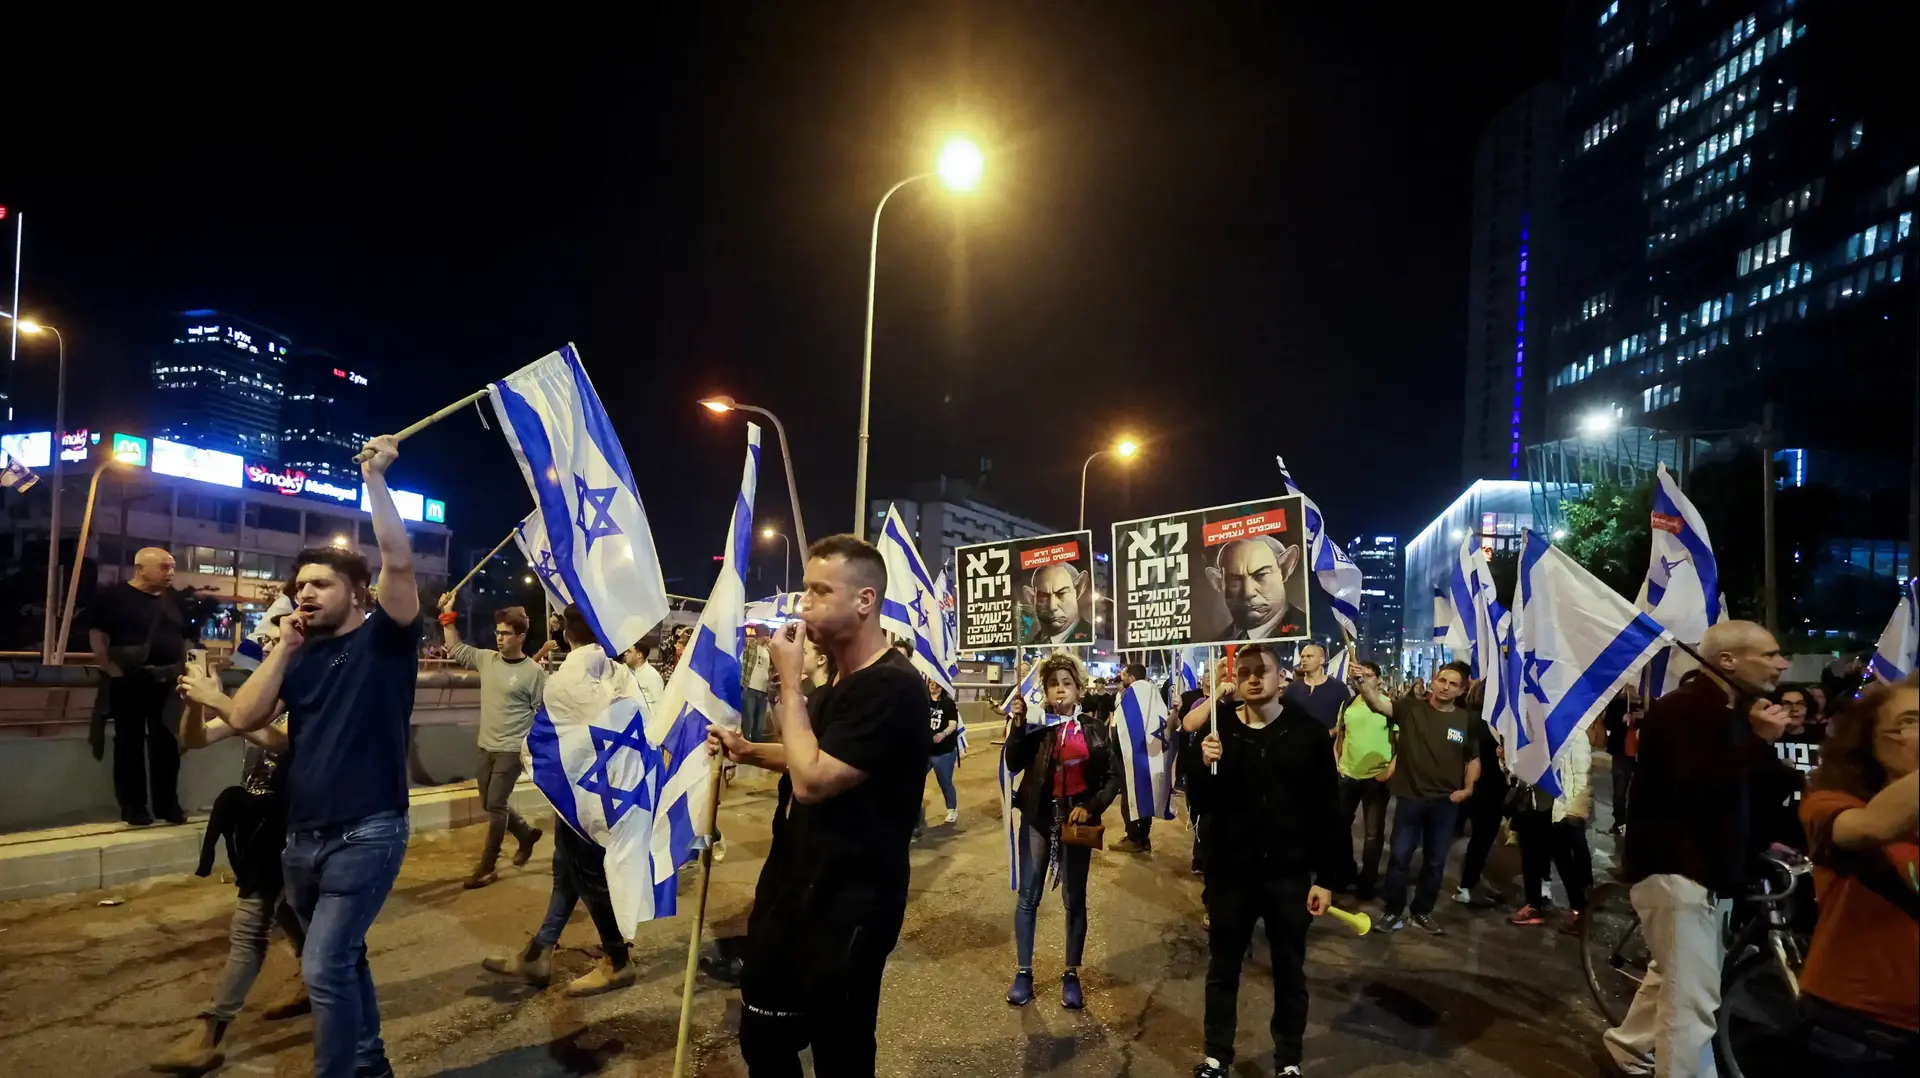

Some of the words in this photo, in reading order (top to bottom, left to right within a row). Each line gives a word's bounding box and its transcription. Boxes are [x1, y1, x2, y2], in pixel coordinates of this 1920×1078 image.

[250, 466, 304, 494] Smoky
[1222, 521, 1242, 530] דורש
[1246, 516, 1264, 526] העם
[1248, 522, 1281, 534] שופטים
[1128, 522, 1188, 559] לא
[1208, 529, 1244, 542] עצמאיים
[966, 548, 1011, 578] לא
[1128, 554, 1188, 591] ניתן
[967, 574, 1011, 603] ניתן
[1128, 585, 1190, 603] לחתולים
[967, 600, 1011, 613] לחתולים
[1128, 599, 1190, 618] לשמור
[967, 610, 1011, 625] לשמור
[1128, 616, 1170, 630] מערכת
[1173, 614, 1191, 625] על
[967, 624, 997, 634] מערכת
[1001, 622, 1012, 631] על
[967, 632, 1012, 644] המשפט
[1128, 625, 1191, 643] המשפט
